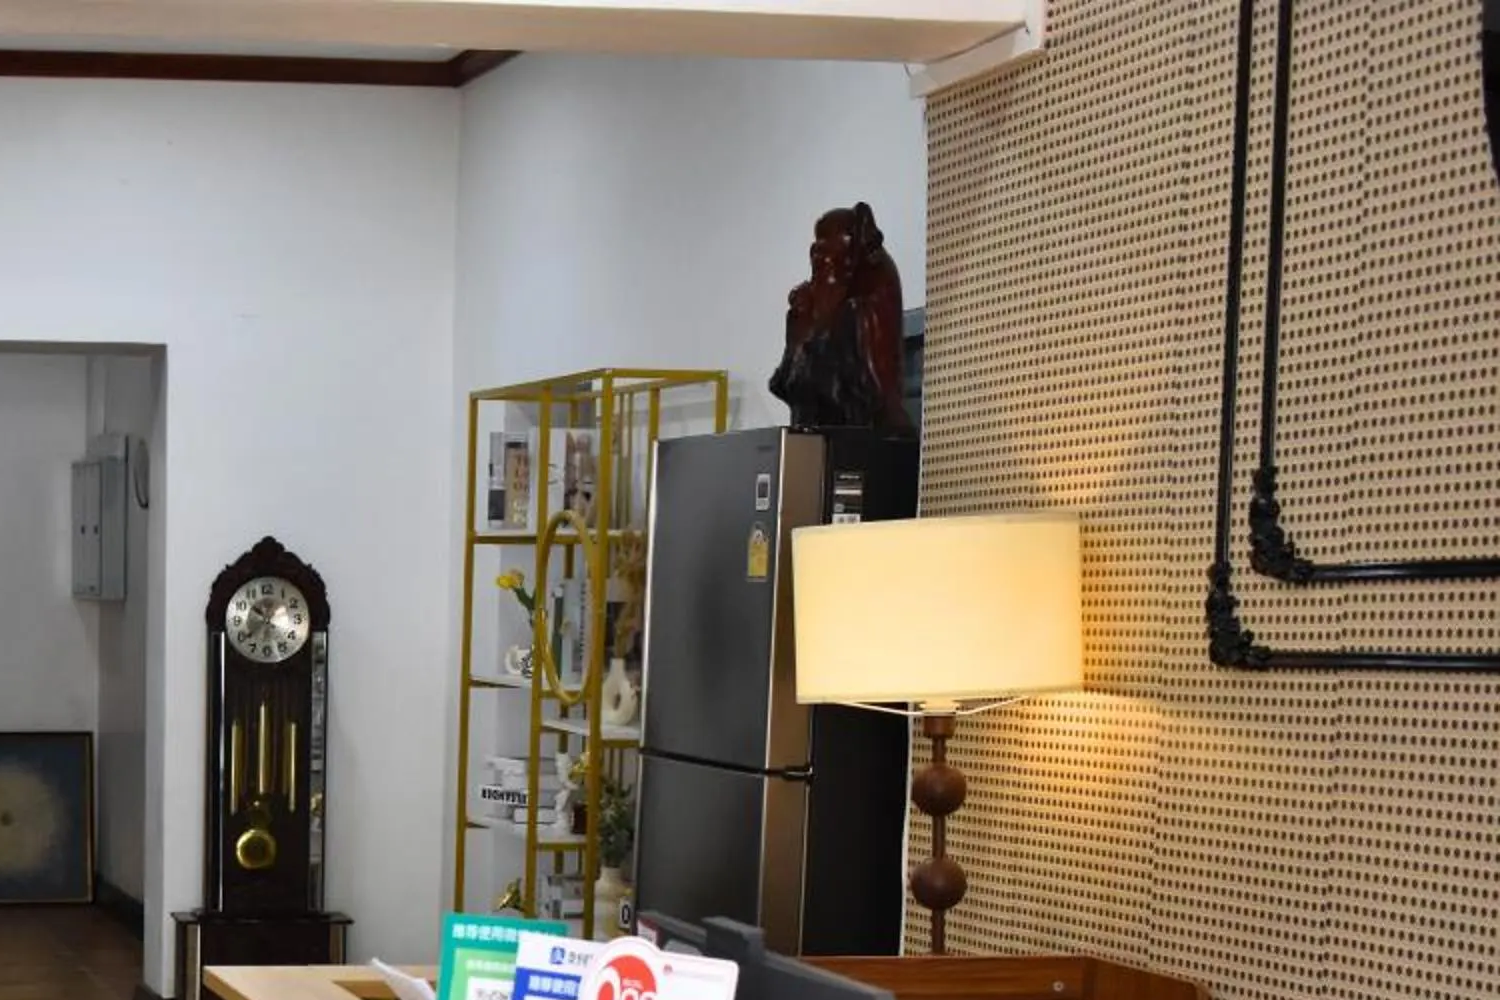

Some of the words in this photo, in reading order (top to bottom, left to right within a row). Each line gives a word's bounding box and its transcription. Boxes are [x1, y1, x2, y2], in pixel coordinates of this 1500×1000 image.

[246, 588, 257, 599] 11
[261, 583, 275, 595] 12
[236, 601, 246, 611] 10
[289, 597, 298, 608] 2
[293, 613, 302, 624] 3
[248, 643, 257, 653] 7
